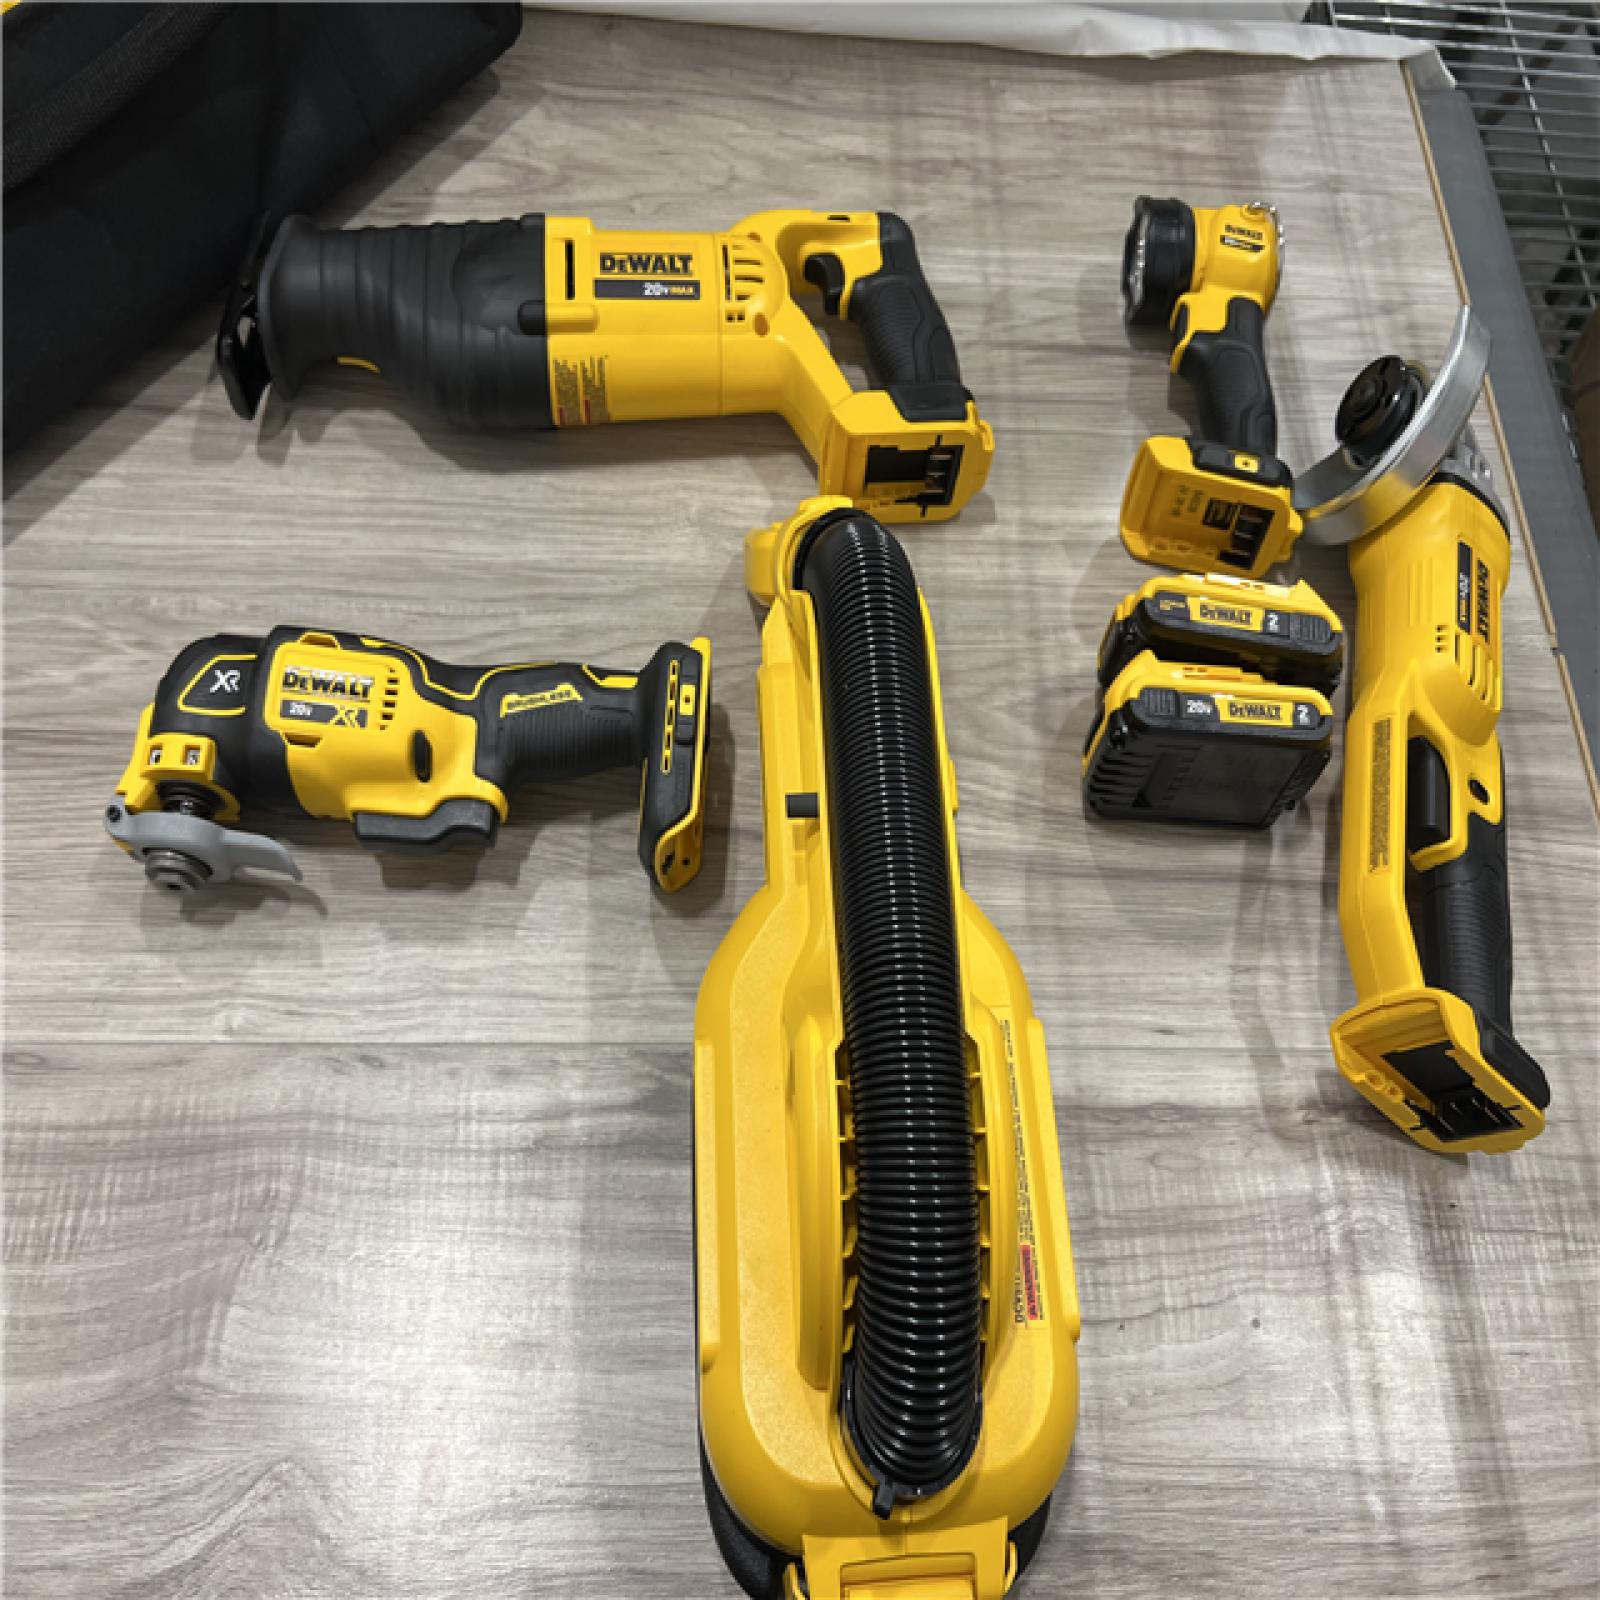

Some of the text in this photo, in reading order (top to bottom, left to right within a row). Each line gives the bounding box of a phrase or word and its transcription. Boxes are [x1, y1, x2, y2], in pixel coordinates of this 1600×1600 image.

[600, 253, 693, 275] DEWALT
[209, 669, 241, 694] XR
[282, 667, 374, 702] DEWALT
